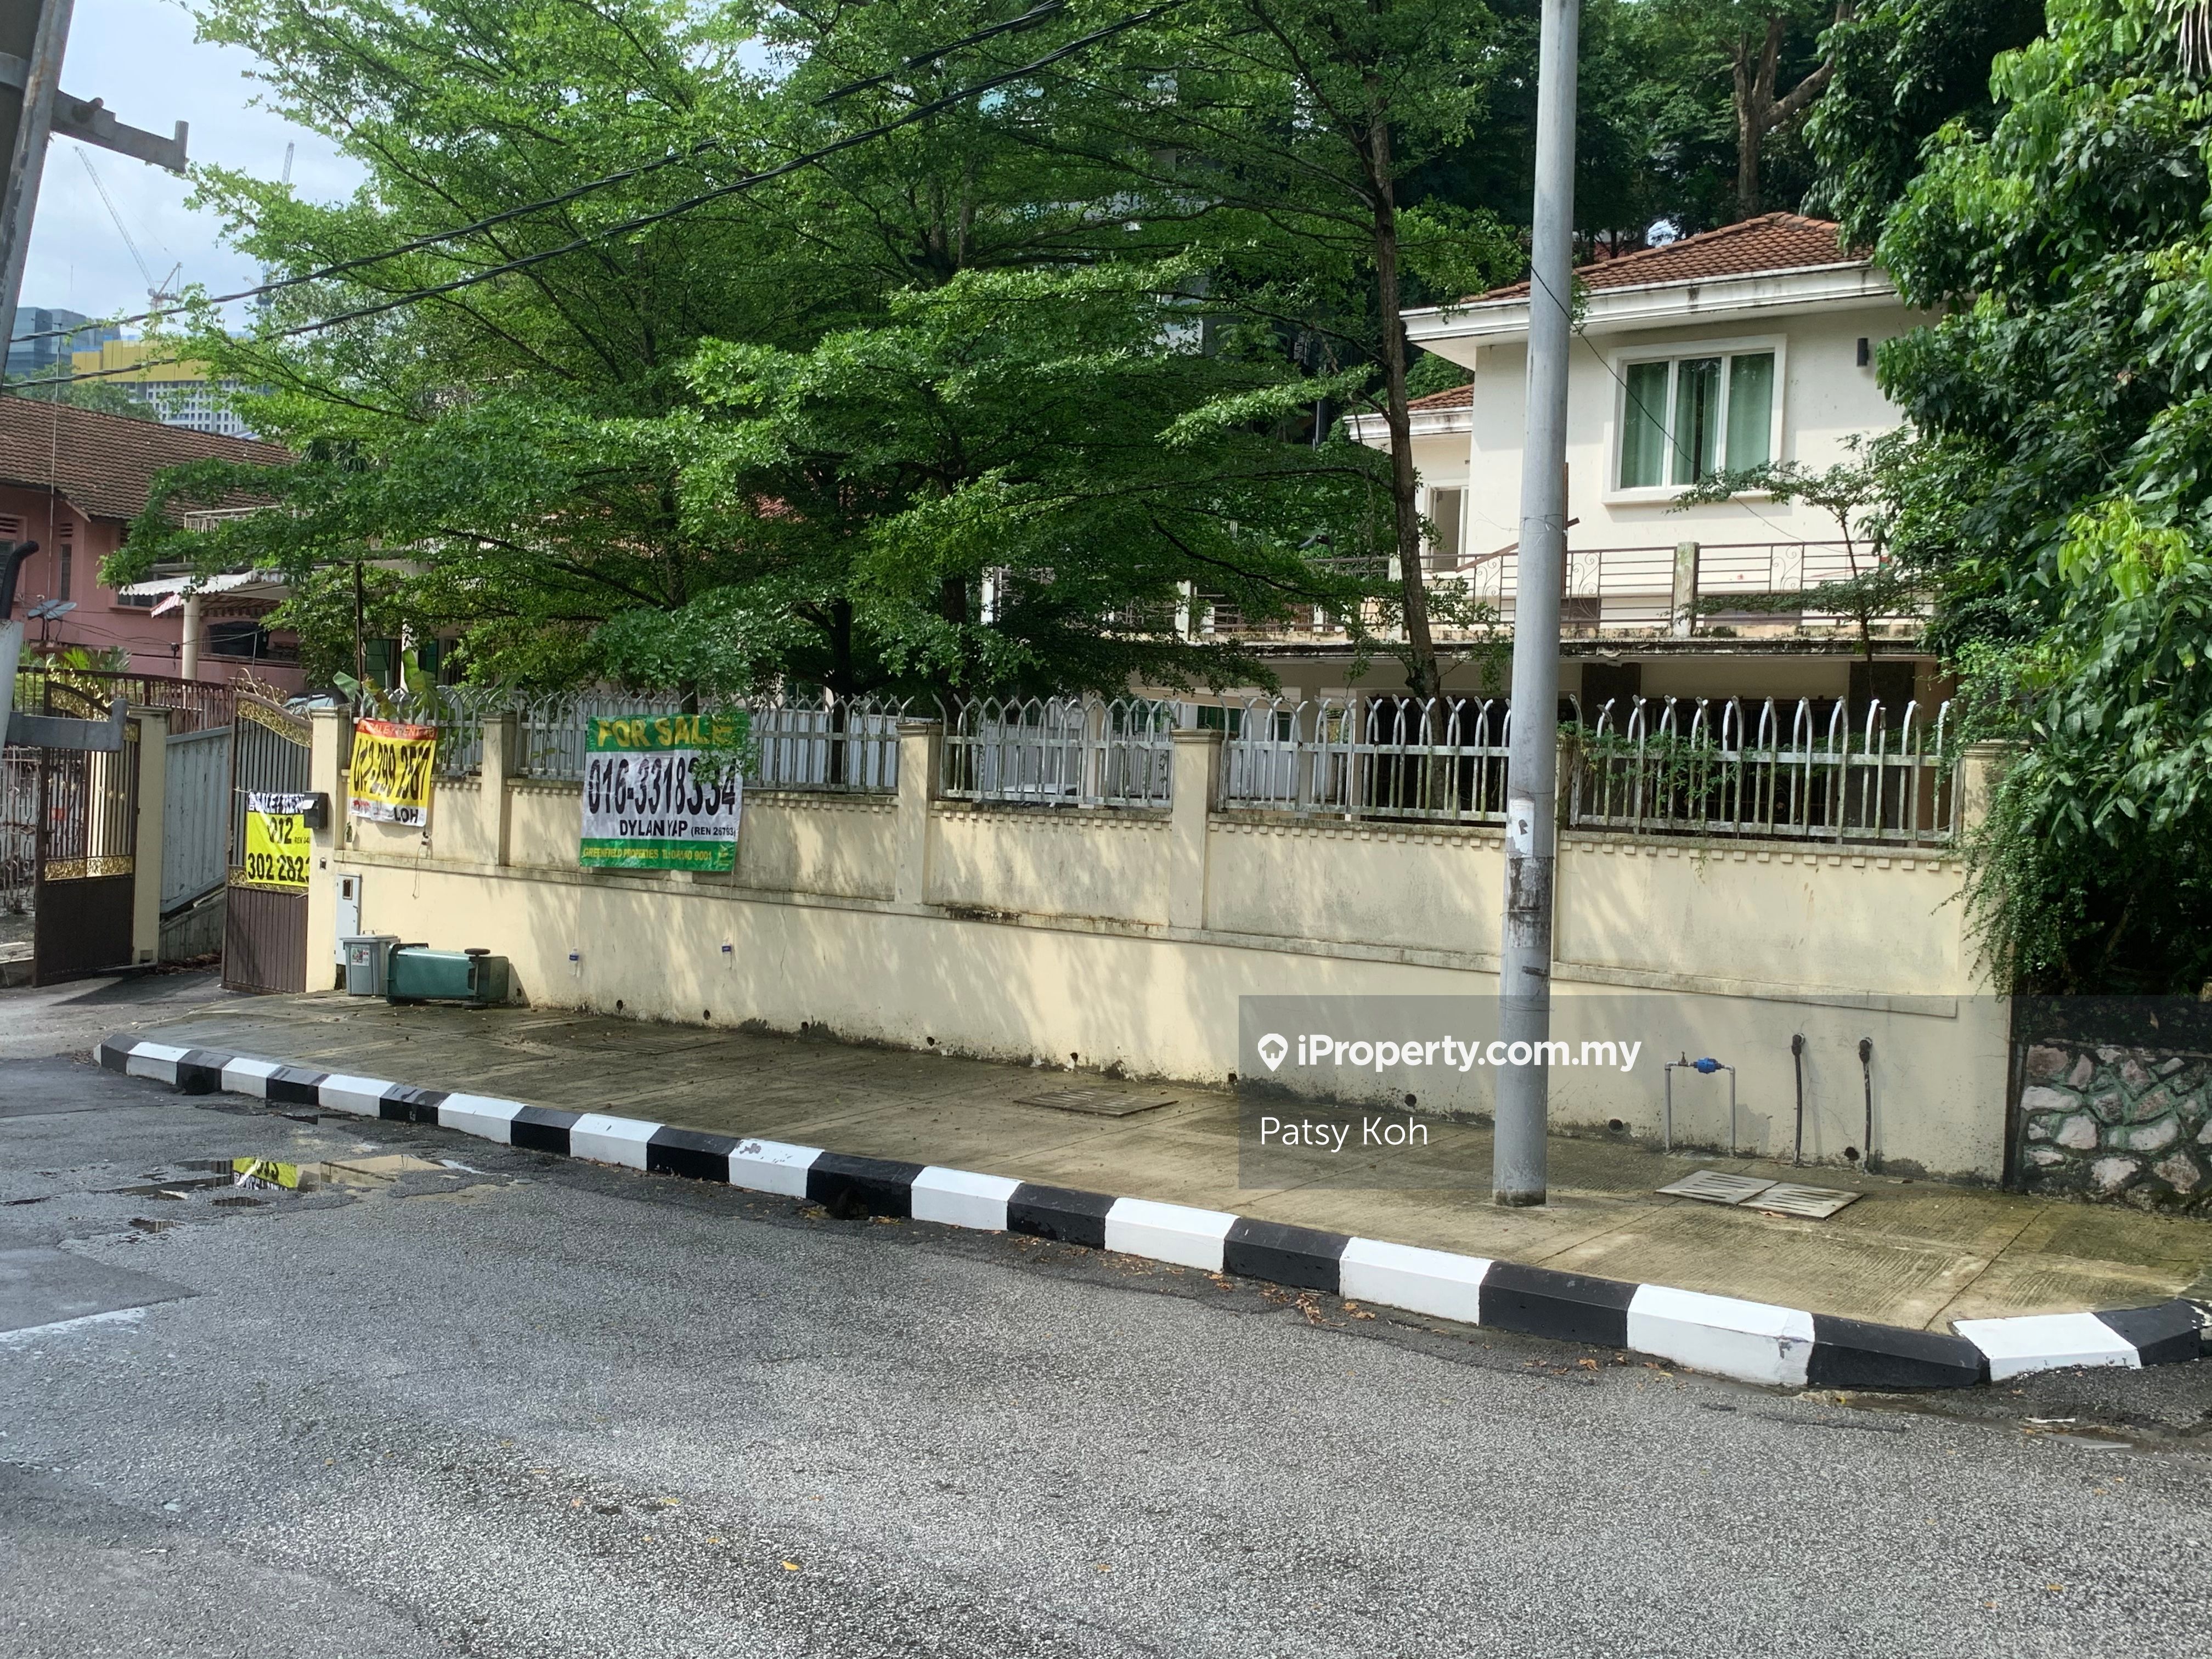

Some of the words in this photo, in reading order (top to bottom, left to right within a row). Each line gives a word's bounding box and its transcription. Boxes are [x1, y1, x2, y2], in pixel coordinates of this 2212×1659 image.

[597, 719, 651, 747] FOR
[654, 715, 734, 746] SALE
[393, 807, 418, 823] LOH
[267, 817, 294, 844] 012
[620, 820, 664, 836] DYLAN
[667, 820, 688, 837] YAP
[691, 826, 711, 837] (REN
[583, 847, 623, 858] GREENFIELD
[248, 852, 274, 880] 302
